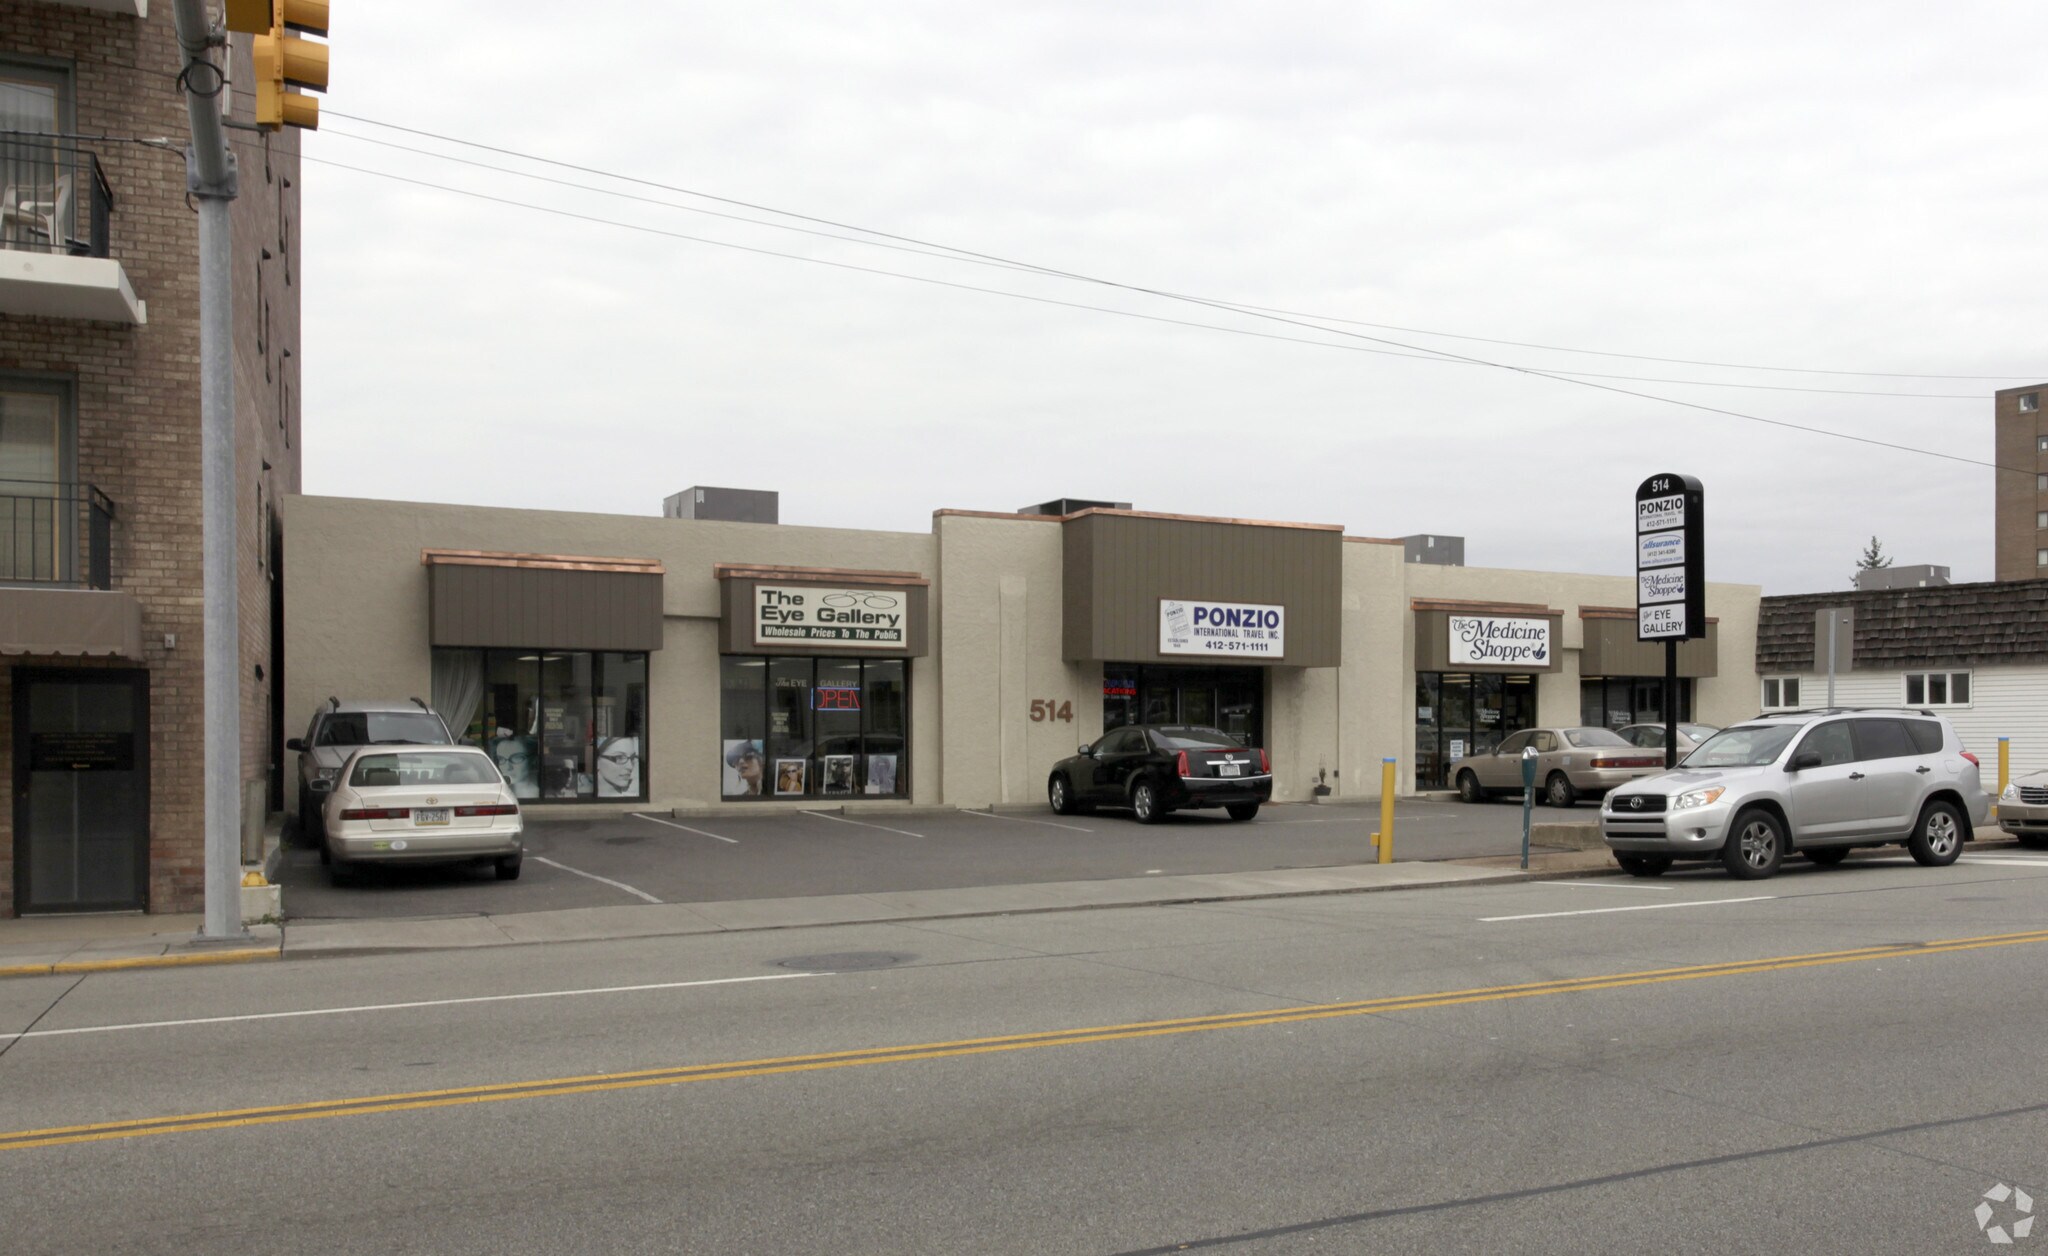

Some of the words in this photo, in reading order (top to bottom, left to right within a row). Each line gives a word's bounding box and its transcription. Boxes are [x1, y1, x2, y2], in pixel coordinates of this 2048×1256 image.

[1652, 478, 1669, 493] 514
[1640, 497, 1683, 515] PONZIO
[1646, 517, 1678, 527] 412-571-1111
[1643, 538, 1681, 550] allsurance
[1644, 572, 1684, 589] Medicine
[1648, 584, 1676, 597] Shoppe
[761, 590, 804, 606] The
[761, 605, 804, 624] Eye
[816, 607, 900, 627] Gallery
[1193, 606, 1280, 630] PONZIO
[1654, 609, 1671, 620] EYE
[765, 626, 806, 637] Wholesale
[811, 627, 836, 638] Prices
[841, 628, 850, 639] To
[856, 629, 870, 639] The
[874, 630, 898, 640] Public
[1194, 627, 1239, 638] INTERNATIONAL
[1243, 629, 1264, 639] TRAVEL
[1268, 630, 1280, 640] INC.
[1452, 619, 1468, 631] The
[1461, 619, 1546, 643] Medicine
[1643, 621, 1684, 634] GALLERY
[1205, 640, 1269, 651] 412-571-1111
[1469, 638, 1531, 661] Shoppe
[790, 679, 807, 688] EYE
[820, 679, 858, 688] GALLERY
[1029, 699, 1074, 724] 514
